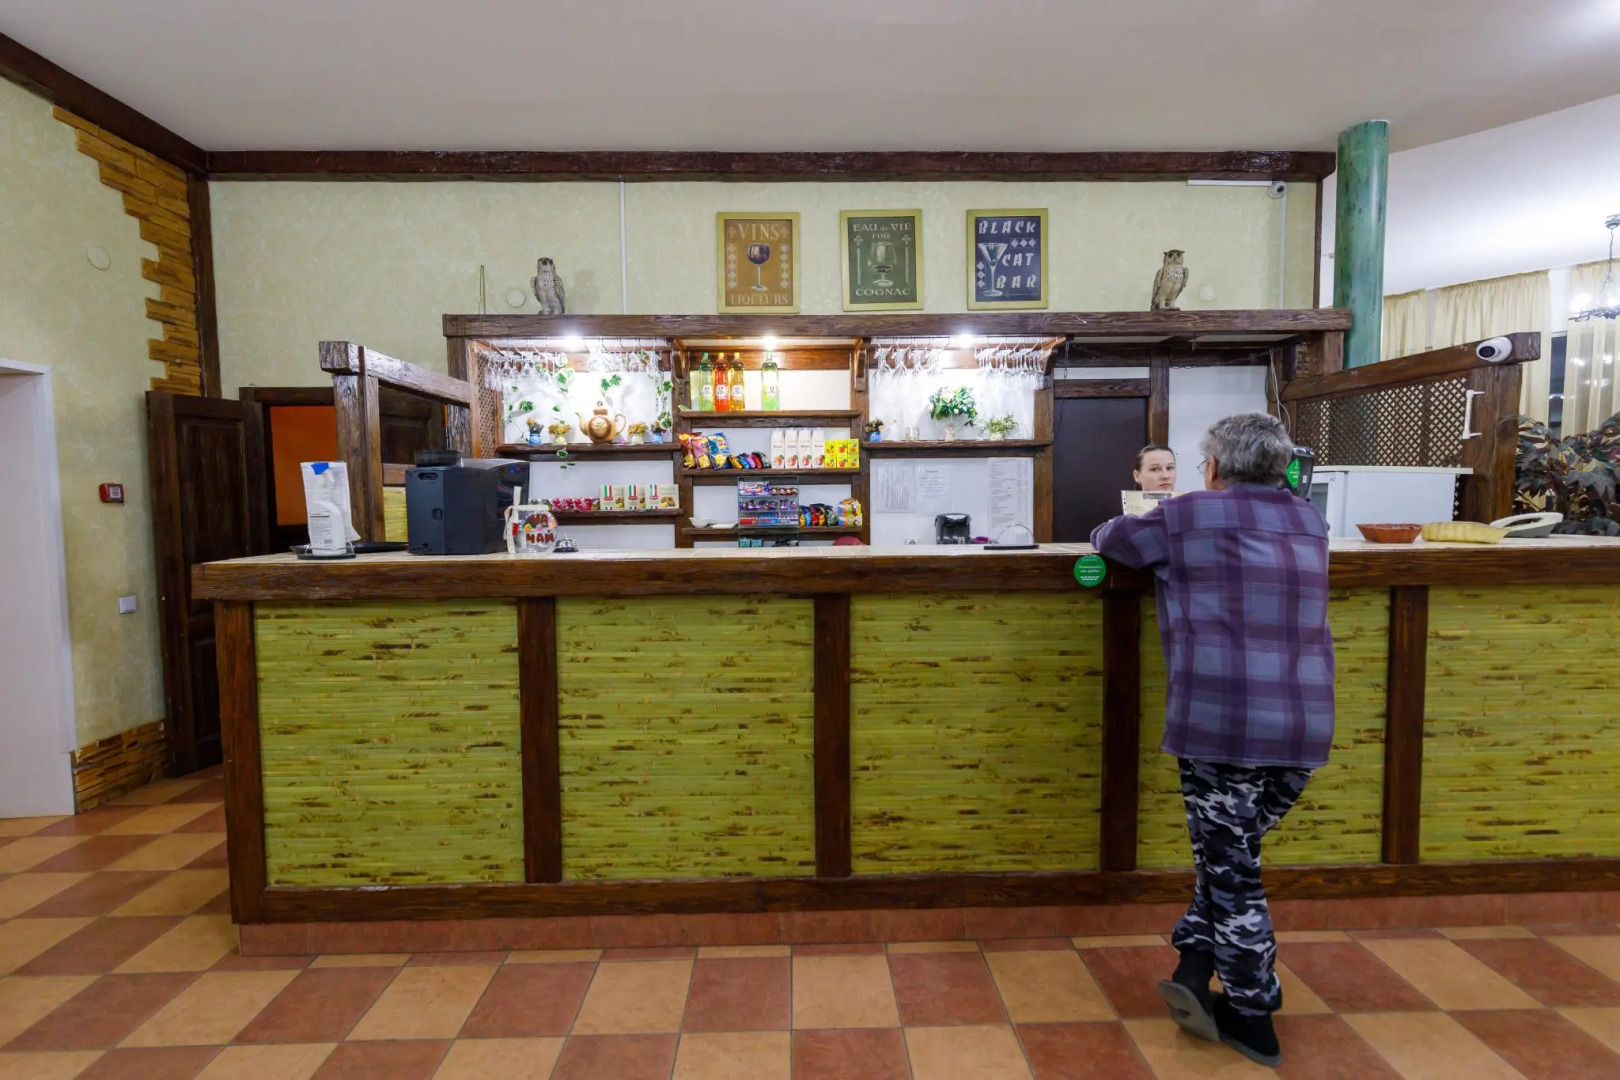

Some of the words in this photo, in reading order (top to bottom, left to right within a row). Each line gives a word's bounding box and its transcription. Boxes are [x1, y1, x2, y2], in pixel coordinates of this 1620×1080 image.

[737, 223, 780, 241] VINS
[853, 223, 878, 232] EAU
[890, 222, 912, 231] VIE
[978, 220, 1036, 234] BLACK
[1001, 252, 1035, 267] CAT
[996, 273, 1037, 289] BAR
[730, 293, 789, 305] LIQUEURS
[855, 288, 911, 297] COGNAC
